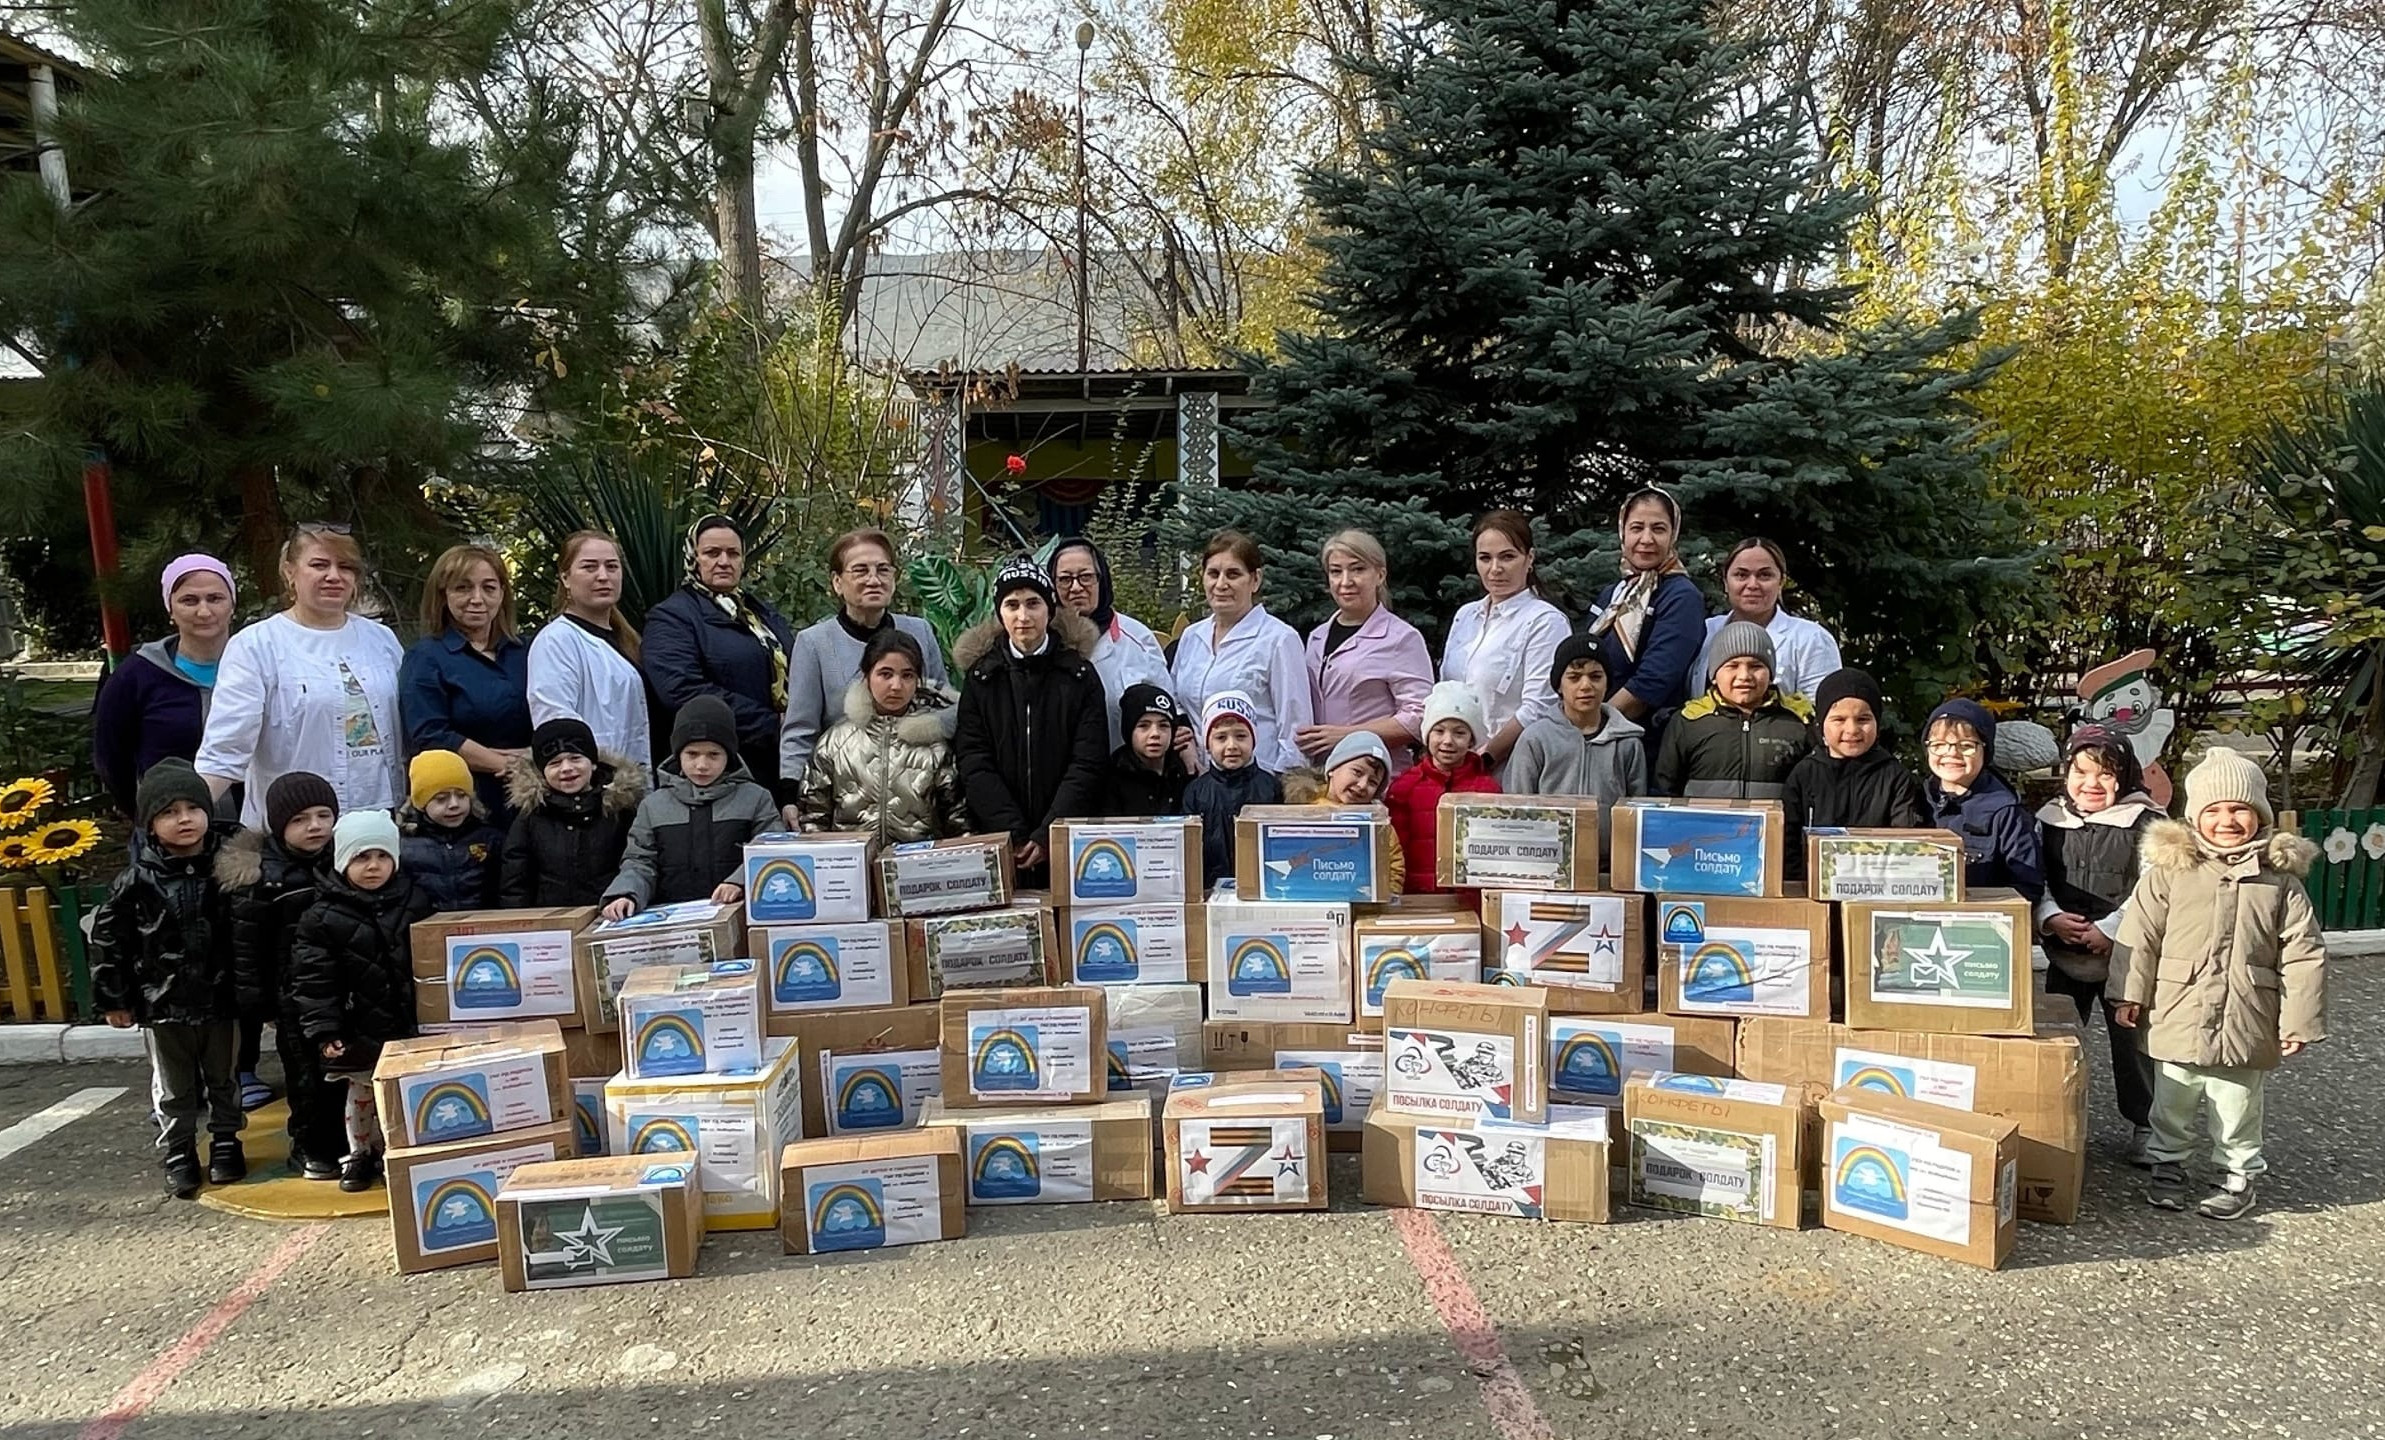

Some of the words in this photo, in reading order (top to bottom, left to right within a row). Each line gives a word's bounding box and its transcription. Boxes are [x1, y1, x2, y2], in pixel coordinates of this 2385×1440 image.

[352, 749, 369, 757] OUR
[1468, 843, 1511, 856] ПОДАРОК
[1516, 845, 1559, 858] СОЛДАТУ
[1695, 848, 1741, 863] Письмо
[1312, 858, 1355, 870] Письмо
[1694, 863, 1743, 877] солдату
[1312, 871, 1357, 882] солдату
[900, 881, 942, 896] ПОДАРОК
[946, 876, 987, 891] СОЛДАТУ
[1836, 883, 1885, 895] ПОДАРОК
[1891, 884, 1939, 896] СОЛДАТУ
[941, 956, 984, 969] ПОДАРОК
[988, 951, 1029, 965] СОЛДАТУ
[1963, 961, 1999, 969] письмо
[1963, 971, 2000, 981] солдату
[1394, 1001, 1504, 1027] КОНФЕТЫ
[1393, 1094, 1437, 1109] ПОСЫЛКА
[1438, 1099, 1483, 1113] СОЛДАТУ
[1637, 1092, 1731, 1118] КОНФЕТЫ
[1645, 1162, 1692, 1181] ПОДАРОК
[1699, 1171, 1745, 1188] СОЛДАТУ
[1421, 1193, 1467, 1208] ПОСЫЛКА
[1468, 1198, 1514, 1213] СОЛДАТУ
